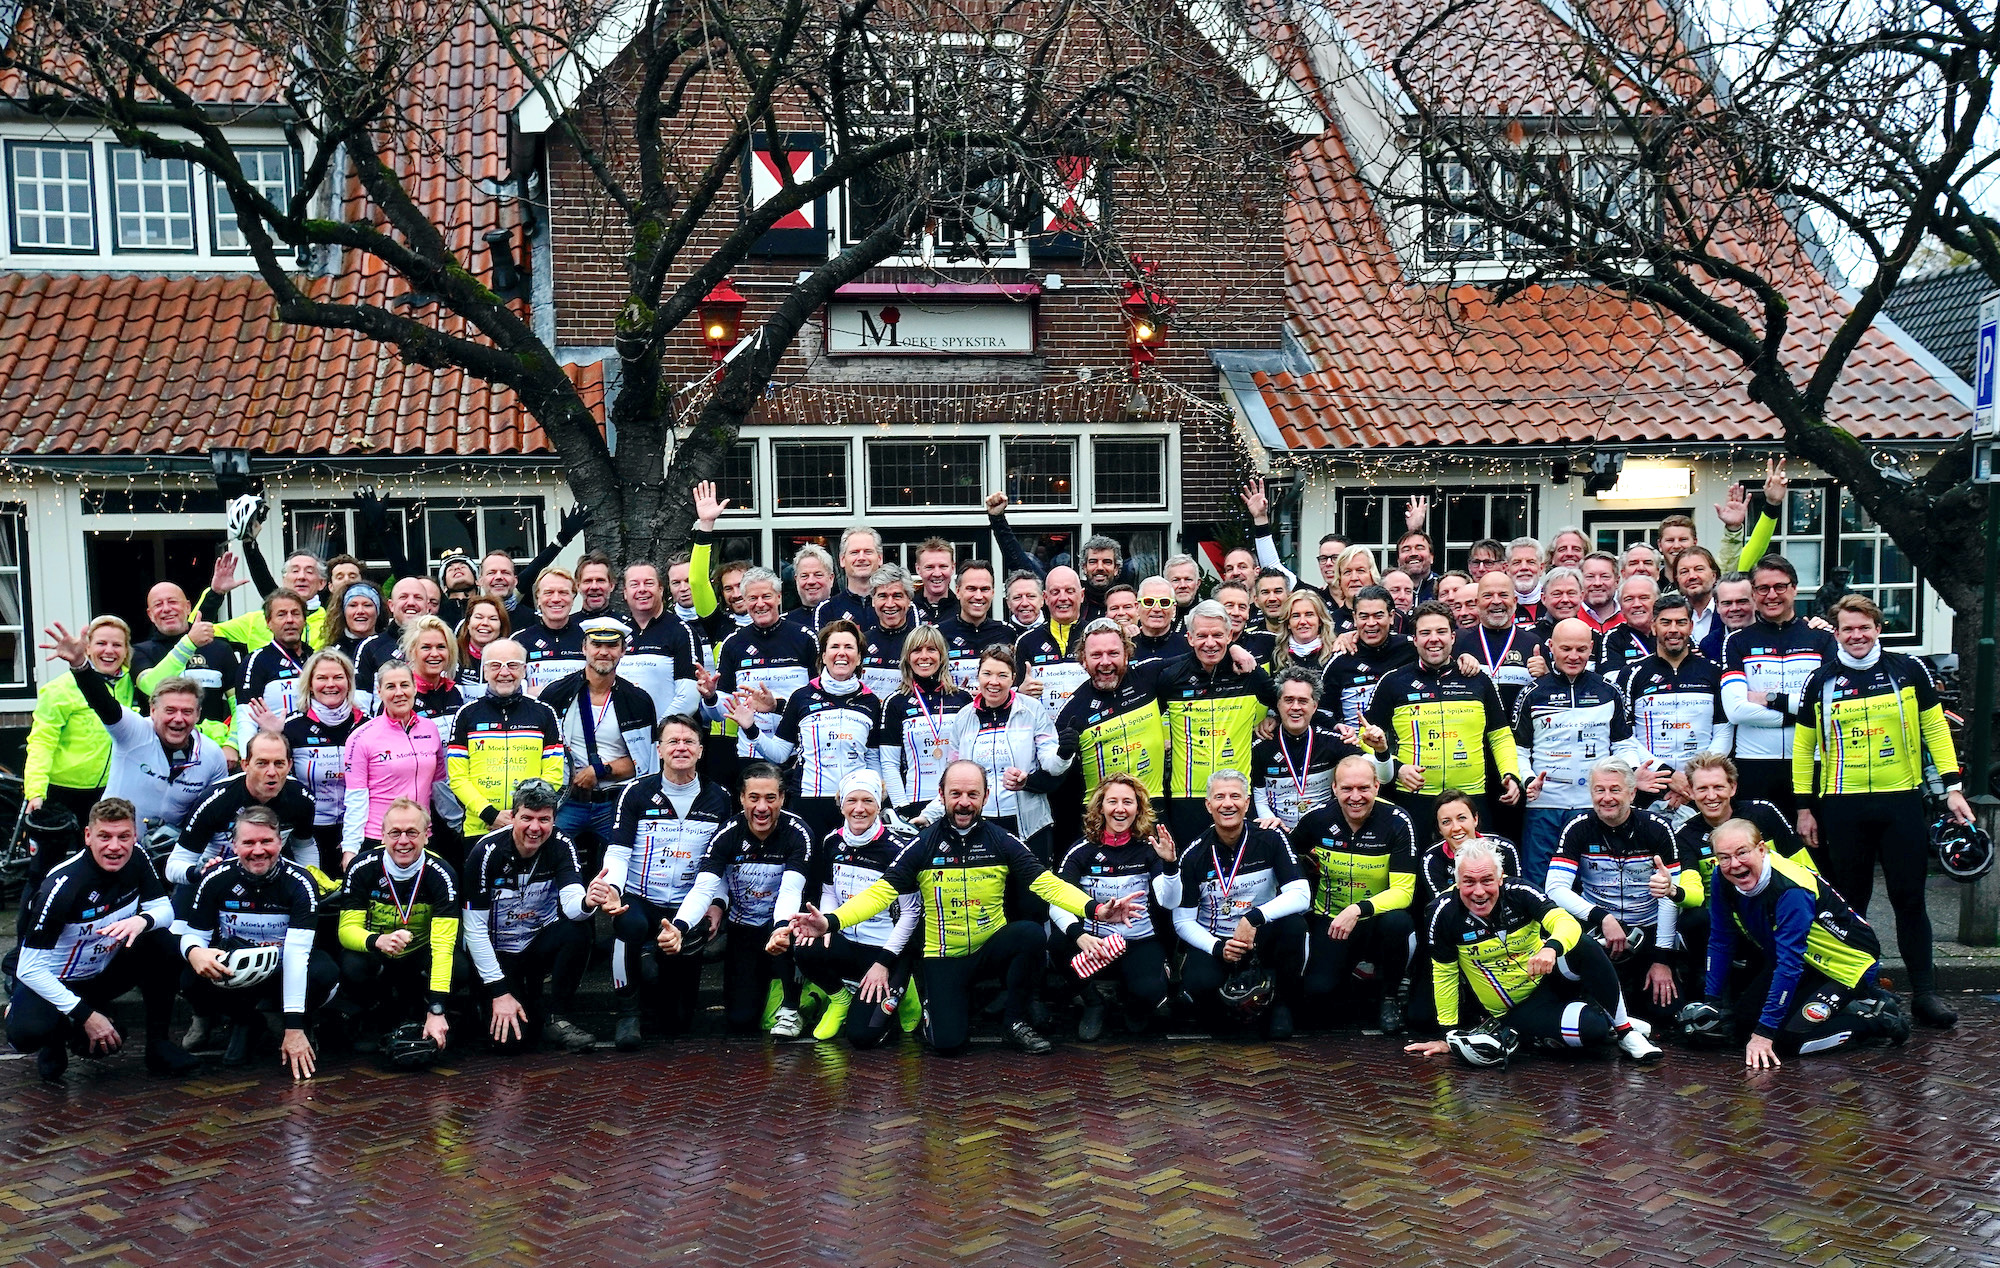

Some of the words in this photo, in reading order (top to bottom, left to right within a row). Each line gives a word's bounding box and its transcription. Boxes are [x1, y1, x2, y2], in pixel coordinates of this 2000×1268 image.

[941, 336, 1007, 347] SPYKSTRA
[1980, 335, 1993, 397] P
[1661, 720, 1691, 730] fixers
[828, 731, 853, 741] fixers
[1199, 726, 1227, 737] fixers
[1428, 729, 1459, 740] fixers
[1851, 726, 1885, 737] fixers
[488, 744, 509, 752] Moeke
[924, 738, 950, 747] fixers
[1111, 741, 1142, 755] fixers
[478, 778, 502, 790] Regus
[662, 847, 692, 859] fixers
[946, 875, 968, 884] Moeke
[1337, 878, 1367, 889] fixers
[950, 897, 981, 909] fixers
[506, 910, 536, 921] fixers
